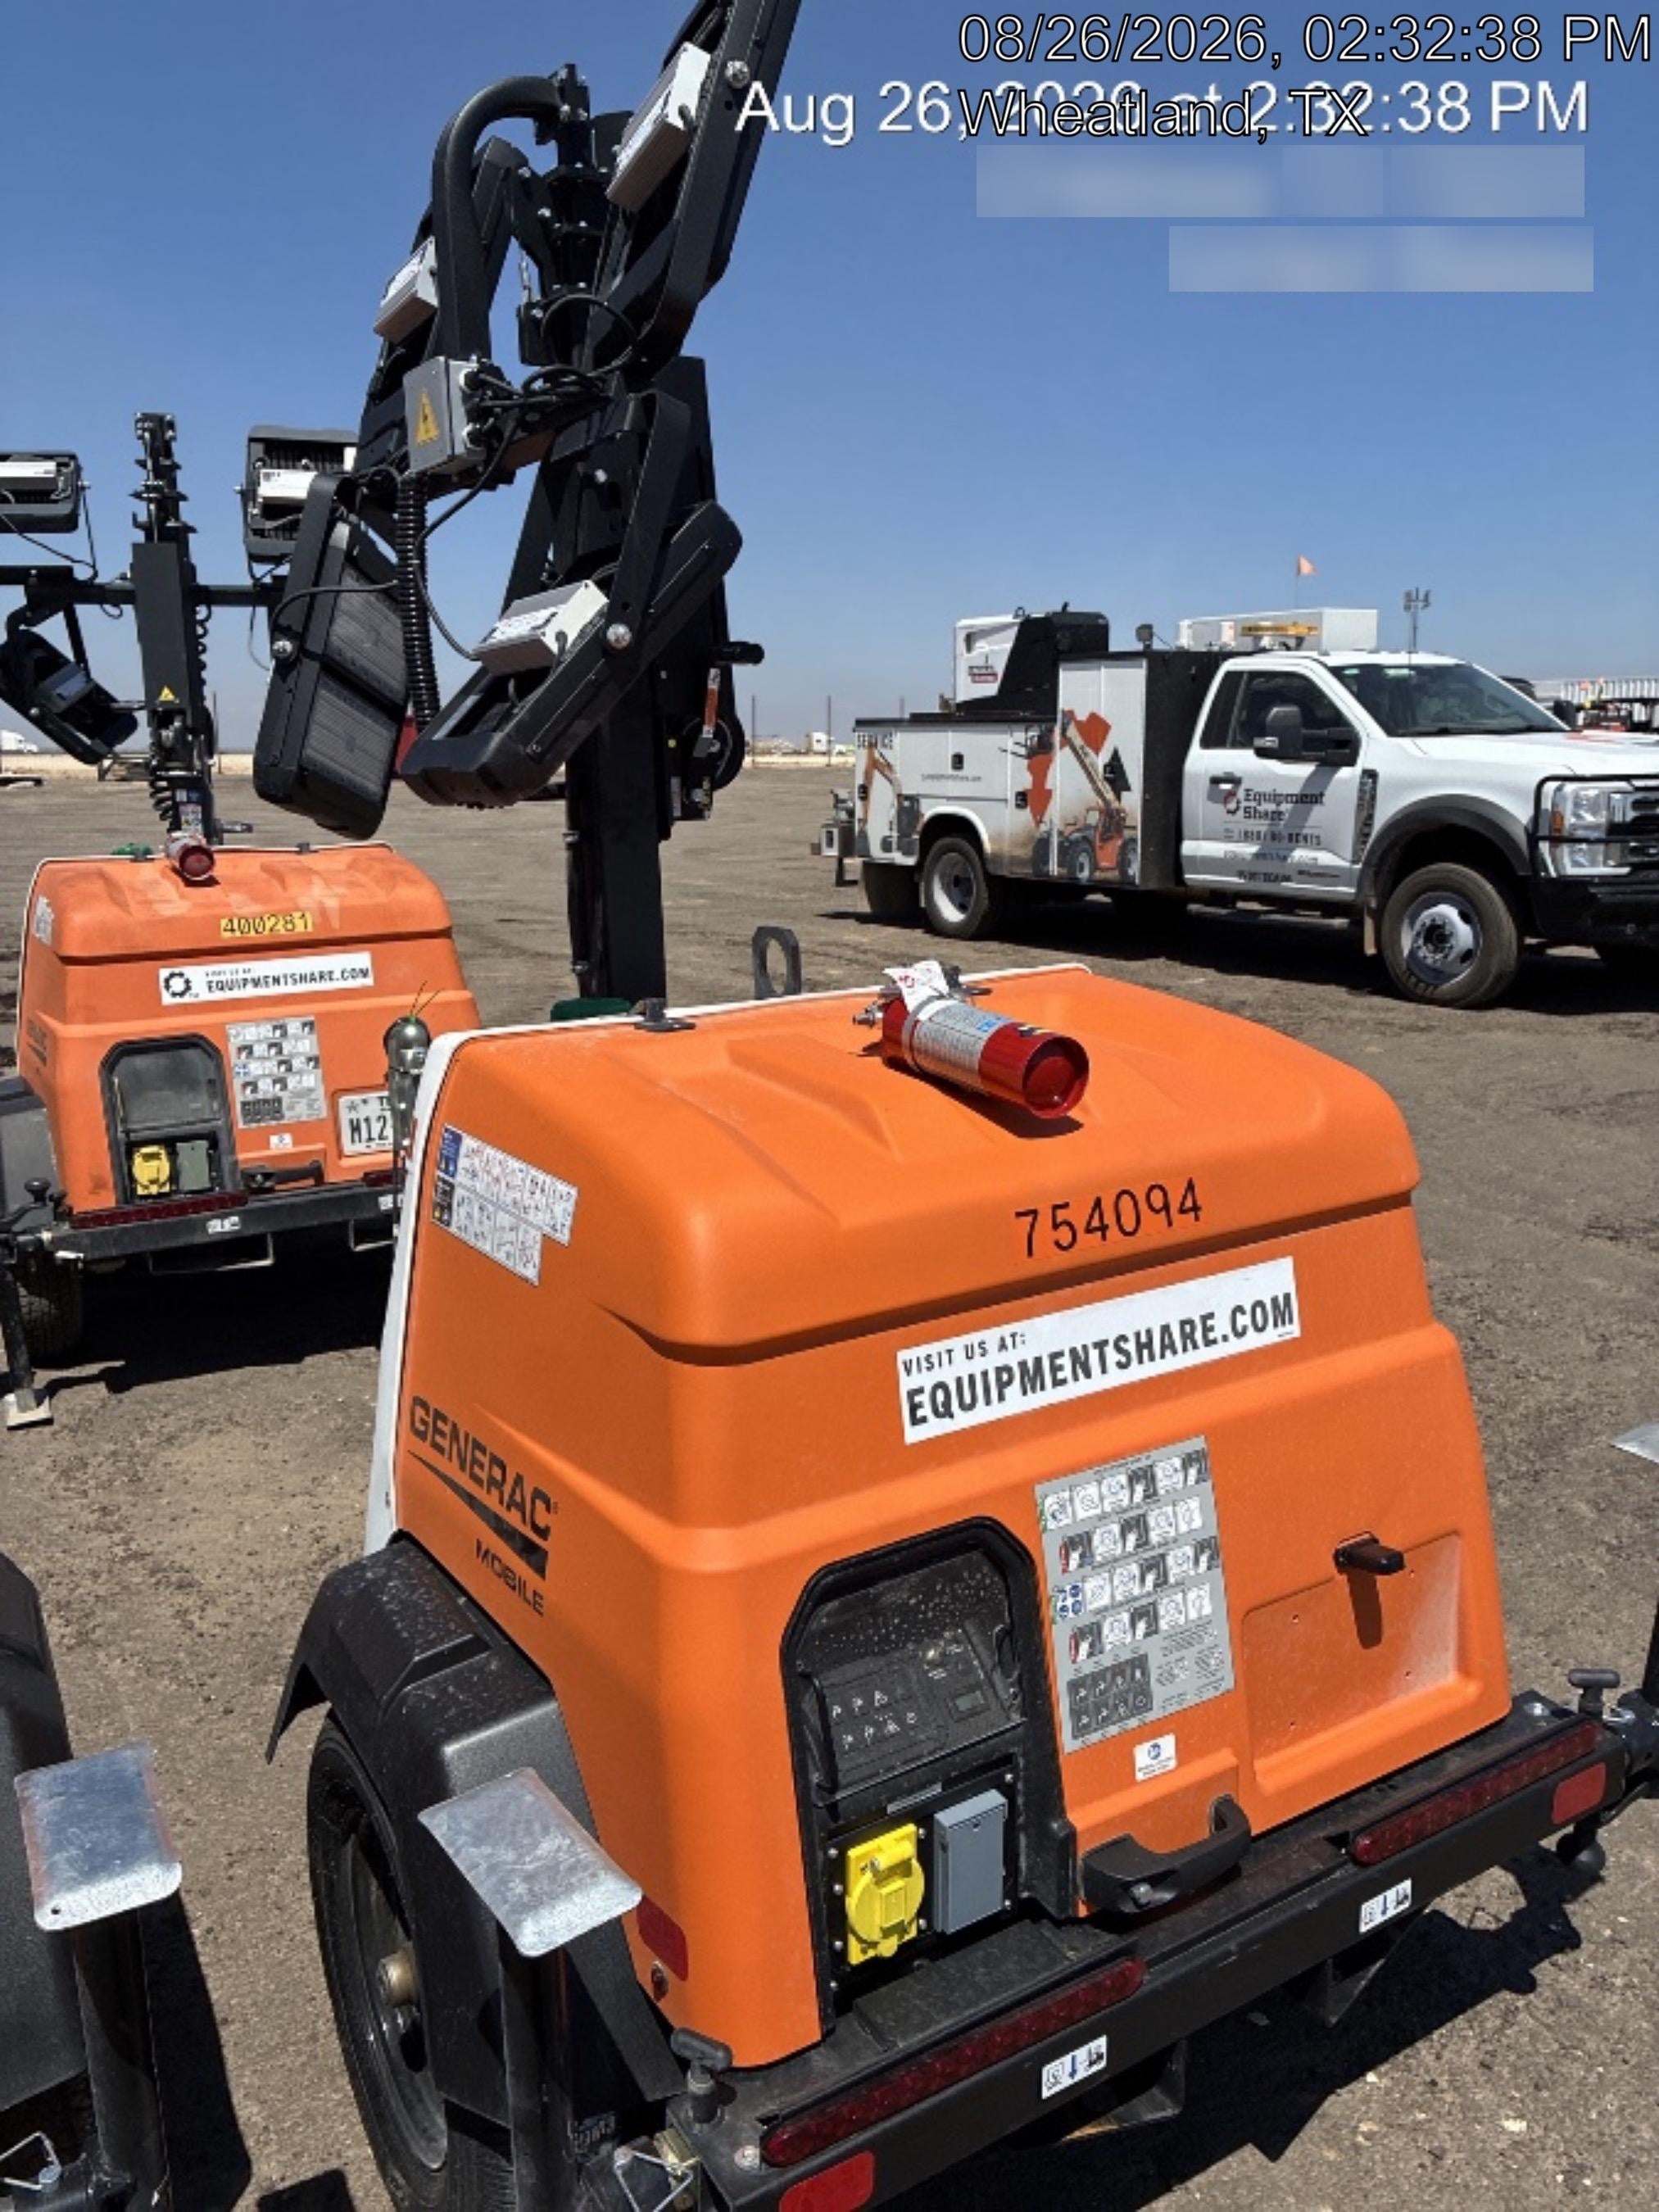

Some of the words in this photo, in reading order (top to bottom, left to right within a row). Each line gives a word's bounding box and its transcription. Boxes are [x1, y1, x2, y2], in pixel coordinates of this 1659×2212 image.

[1244, 788, 1325, 807] Equipment
[222, 913, 311, 936] 400281
[206, 967, 370, 993] EQUIPMENTSHARE.COM
[1015, 1176, 1203, 1259] 754094
[902, 1348, 954, 1376] VISIT
[963, 1340, 989, 1360] US
[997, 1332, 1027, 1353] AT:
[906, 1290, 1295, 1426] EQUIPMENTSHARE.COM
[410, 1394, 552, 1543] GENERAC
[475, 1537, 546, 1618] MOBILE
